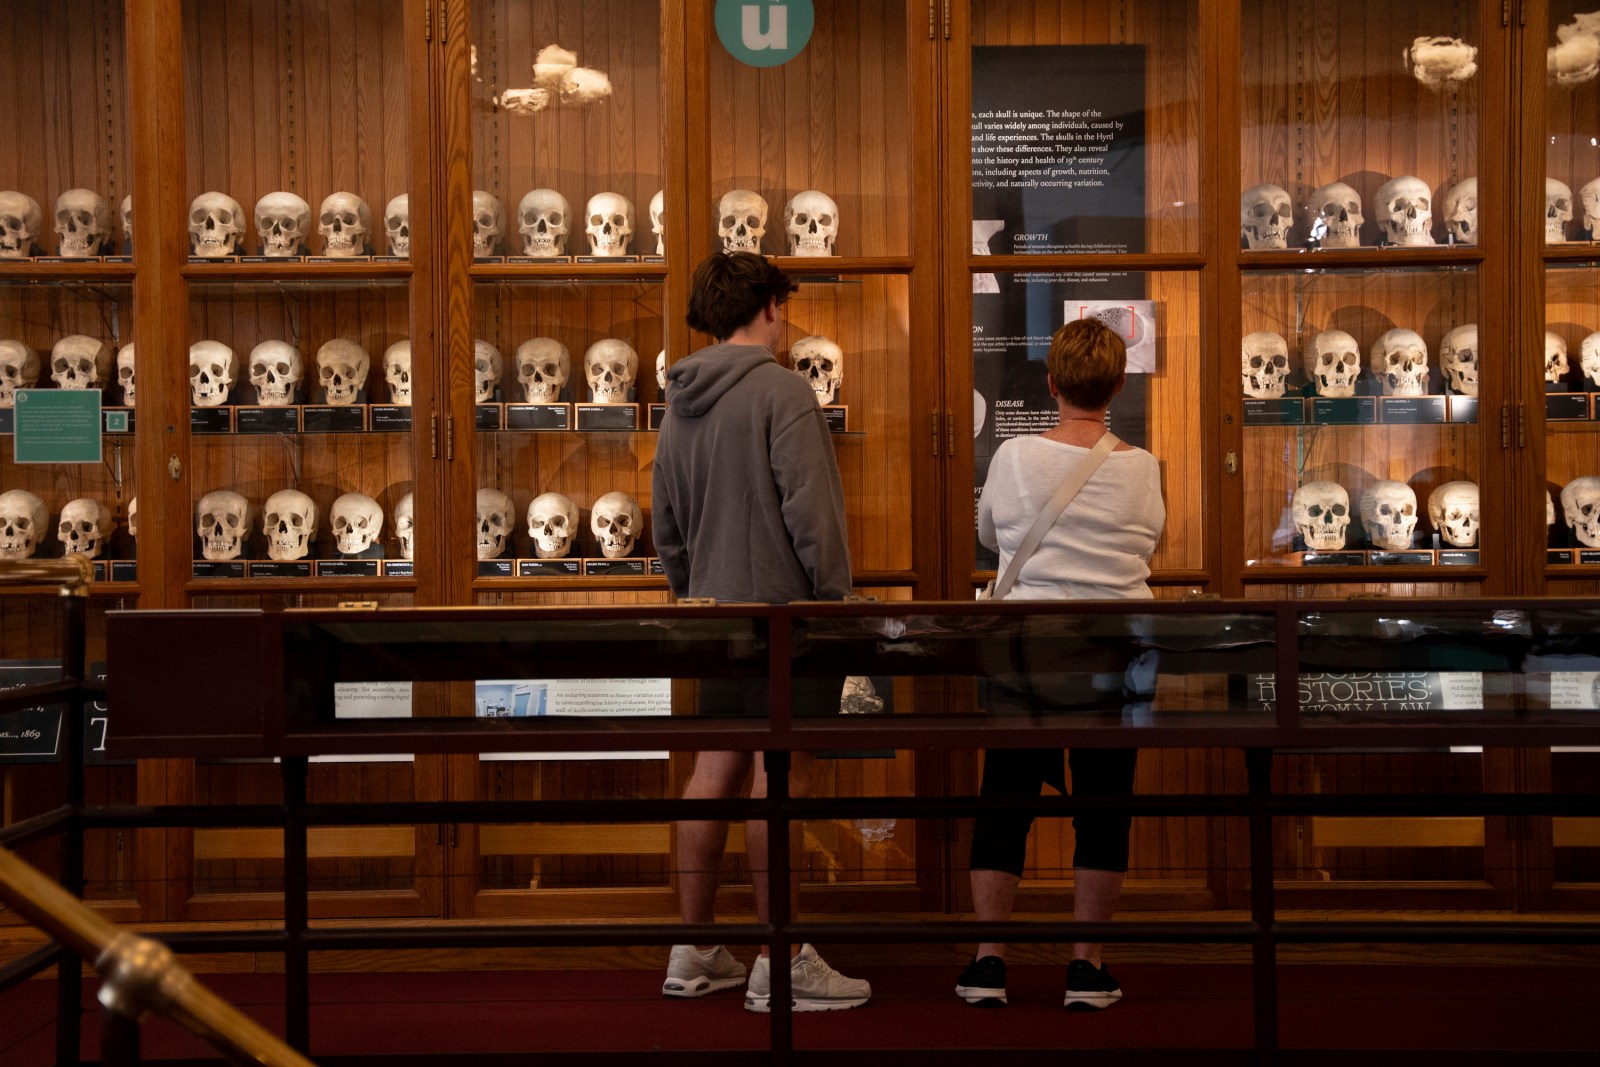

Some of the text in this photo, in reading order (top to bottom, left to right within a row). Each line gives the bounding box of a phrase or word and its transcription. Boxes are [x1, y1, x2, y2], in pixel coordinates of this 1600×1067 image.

[978, 110, 994, 118] each
[995, 110, 1011, 118] skull
[1012, 110, 1018, 118] is
[1019, 110, 1045, 120] unique.
[1046, 110, 1060, 118] The
[1061, 110, 1081, 119] shape
[1082, 110, 1090, 118] of
[1091, 110, 1102, 118] the
[984, 121, 1003, 129] varies
[1004, 121, 1027, 131] widely
[1028, 123, 1050, 131] among
[1051, 121, 1090, 129] individuals,
[1091, 121, 1114, 129] caused
[1115, 121, 1124, 131] by
[985, 133, 997, 141] life
[997, 133, 1039, 143] experiences.
[1040, 133, 1054, 141] The
[1055, 133, 1074, 141] skulls
[1075, 133, 1083, 141] in
[1084, 133, 1095, 141] the
[1096, 133, 1114, 142] Hyrtl
[1055, 144, 1073, 154] They
[984, 156, 995, 164] the
[996, 156, 1019, 166] history
[1020, 156, 1033, 164] and
[1034, 156, 1056, 164] health
[1056, 156, 1065, 164] of
[1078, 157, 1104, 166] century
[985, 168, 1017, 178] including
[1018, 169, 1041, 177] aspects
[1042, 168, 1051, 176] of
[1051, 168, 1077, 177] growth,
[1078, 168, 1110, 176] nutrition,
[996, 179, 1009, 187] and
[1010, 179, 1039, 189] naturally
[1039, 179, 1072, 188] occurring
[1073, 179, 1105, 187] variation.
[1014, 233, 1049, 241] GROWTH
[995, 400, 1025, 408] DISEASE
[113, 418, 120, 426] 2
[1255, 679, 1432, 703] HSTORIES:
[20, 729, 41, 740] 1869
